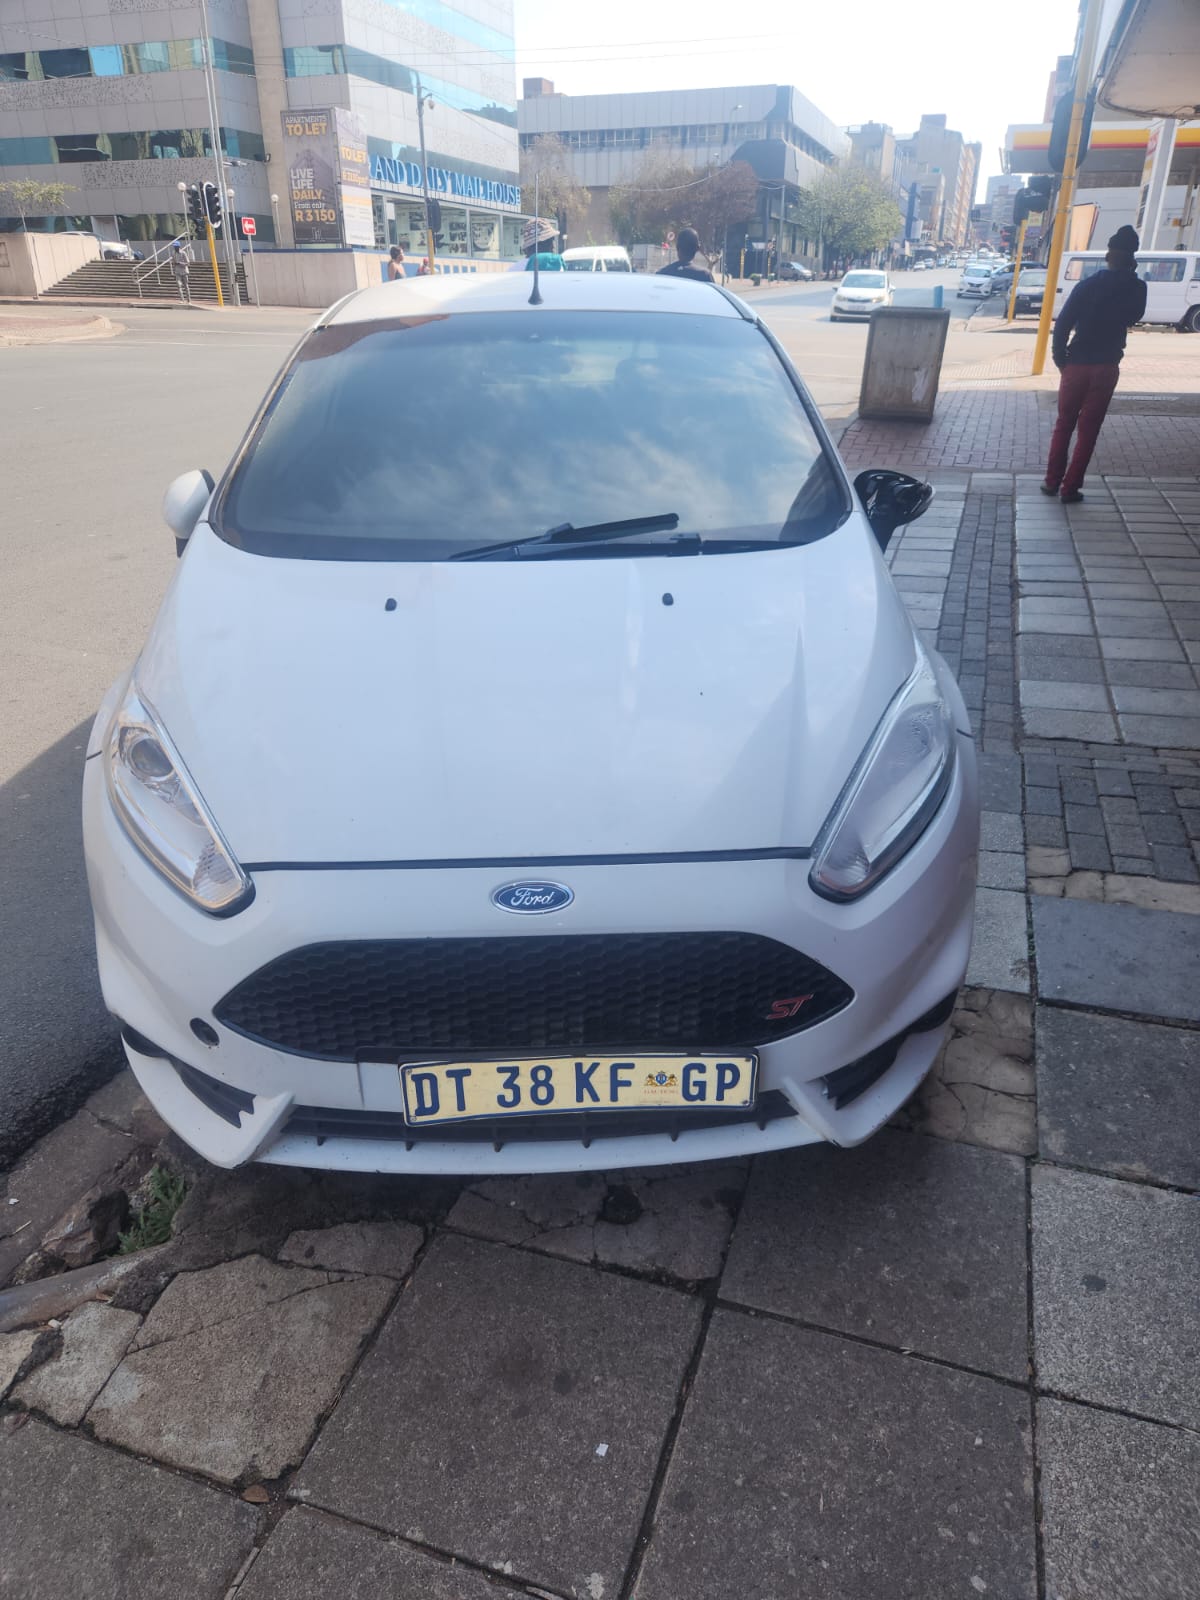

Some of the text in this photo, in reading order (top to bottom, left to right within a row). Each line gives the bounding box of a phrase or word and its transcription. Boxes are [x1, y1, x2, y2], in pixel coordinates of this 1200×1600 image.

[286, 122, 327, 136] TO LET
[341, 146, 367, 164] TO LET
[290, 168, 314, 179] LIVE
[368, 154, 407, 184] AND
[455, 172, 485, 200] MAIL
[487, 180, 521, 206] HOUSE
[292, 179, 314, 189] LIFE
[294, 201, 325, 210] From only
[511, 887, 555, 906] Ford
[765, 993, 815, 1020] ST
[411, 1061, 740, 1116] DT 38 KF GP
